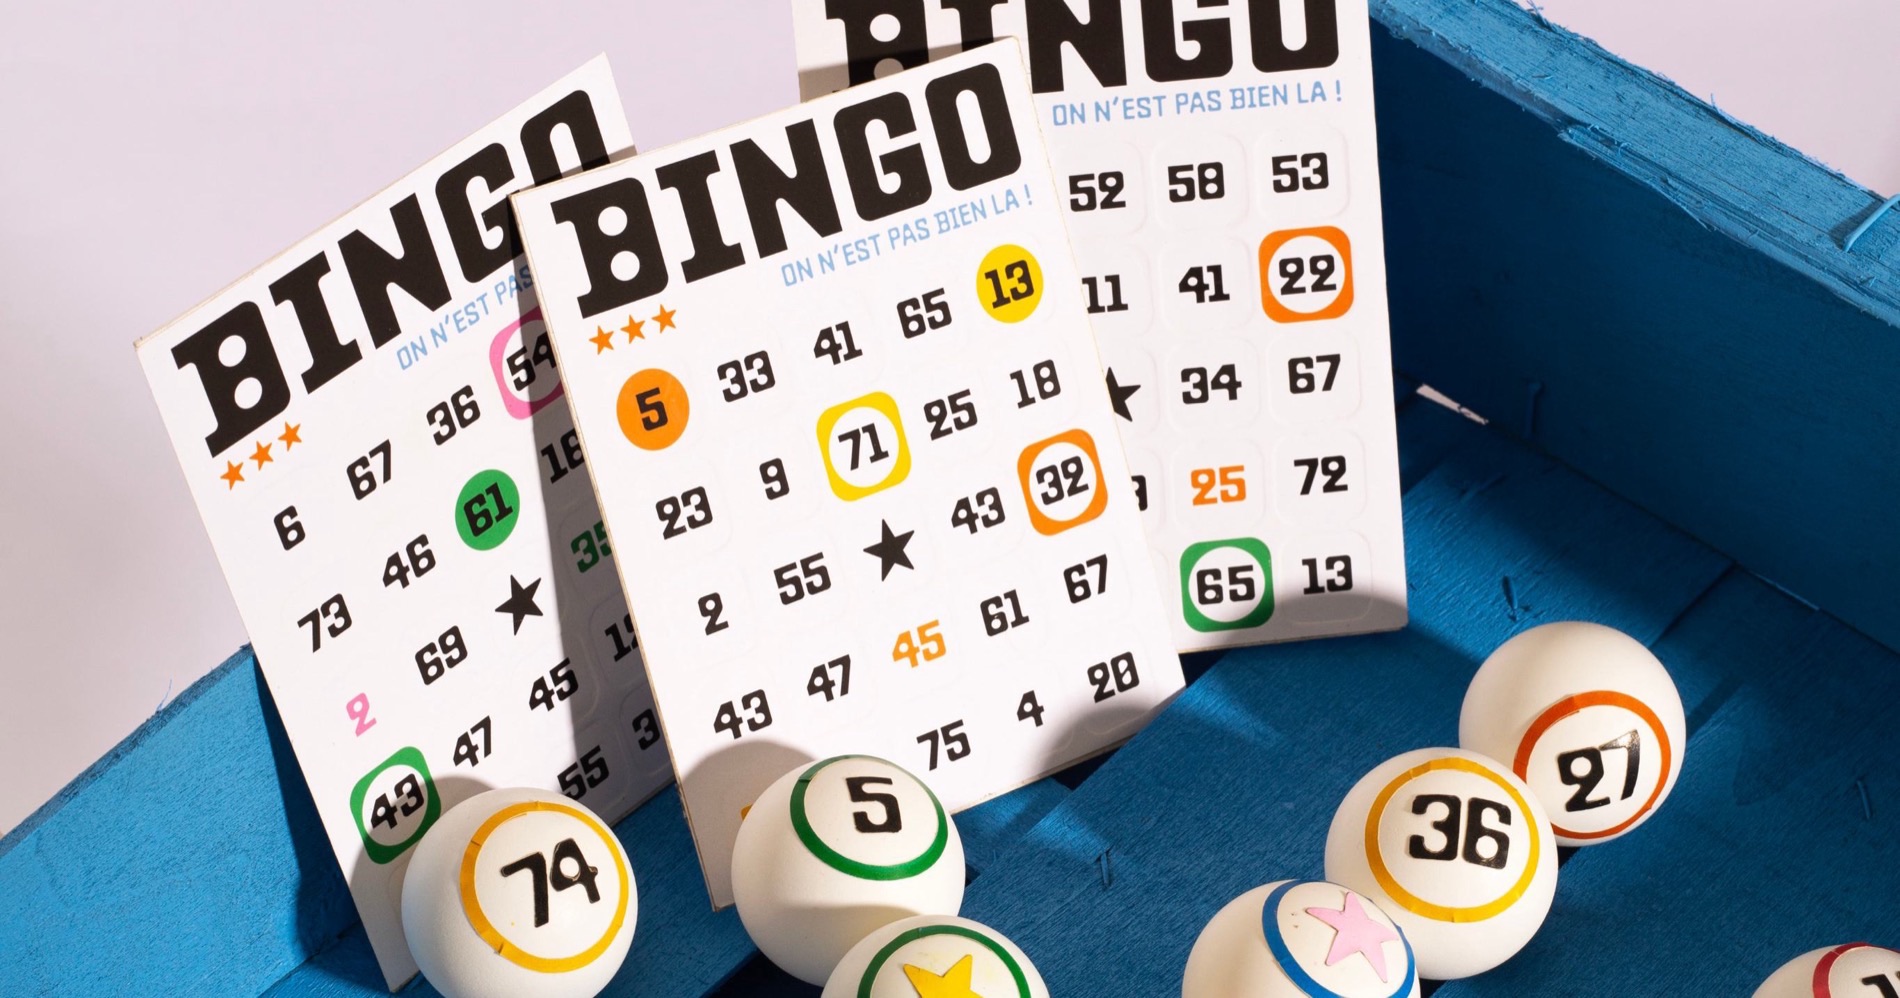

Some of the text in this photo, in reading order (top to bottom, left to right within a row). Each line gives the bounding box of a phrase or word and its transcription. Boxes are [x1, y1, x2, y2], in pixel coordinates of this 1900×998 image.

[1052, 104, 1086, 127] ON
[1094, 96, 1166, 122] N'EST
[1175, 90, 1221, 114] PAS
[1229, 84, 1288, 110] BIEN
[1297, 81, 1327, 104] LA
[550, 62, 1022, 319] BINGO
[1069, 153, 1328, 211] 52 58 53
[170, 90, 611, 458] BINGO
[781, 257, 814, 287] ON
[818, 233, 880, 275] N'EST
[888, 217, 931, 250] PAS
[934, 198, 988, 234] BIEN
[991, 188, 1020, 216] LA
[1082, 255, 1336, 313] 11 41 22
[396, 335, 428, 371] ON
[430, 292, 489, 349] N'EST
[636, 261, 1034, 430] 5 33 41 65 13
[1181, 354, 1340, 403] 34 67
[274, 332, 558, 550] 6 67 36 54
[656, 360, 1060, 539] 23 9 71 25 18
[1190, 465, 1246, 506] 25
[1294, 456, 1347, 494] 72
[298, 594, 351, 652] 73
[383, 535, 435, 588] 46
[463, 482, 513, 537] 61
[698, 593, 728, 635] 2
[774, 553, 831, 604] 55
[952, 488, 1005, 533] 43
[1036, 457, 1088, 504] 32
[1196, 556, 1352, 604] 65 13
[345, 692, 378, 738] 2
[416, 626, 467, 684] 69
[714, 555, 1107, 738] 43 47 45 61 67
[370, 773, 425, 829] 43
[454, 716, 491, 766] 47
[528, 658, 579, 711] 45
[917, 653, 1139, 770] 75 4 20
[557, 745, 610, 800] 55
[846, 776, 902, 833] 5
[1556, 729, 1642, 812] 27
[1408, 793, 1513, 870] 36
[500, 838, 598, 927] 74
